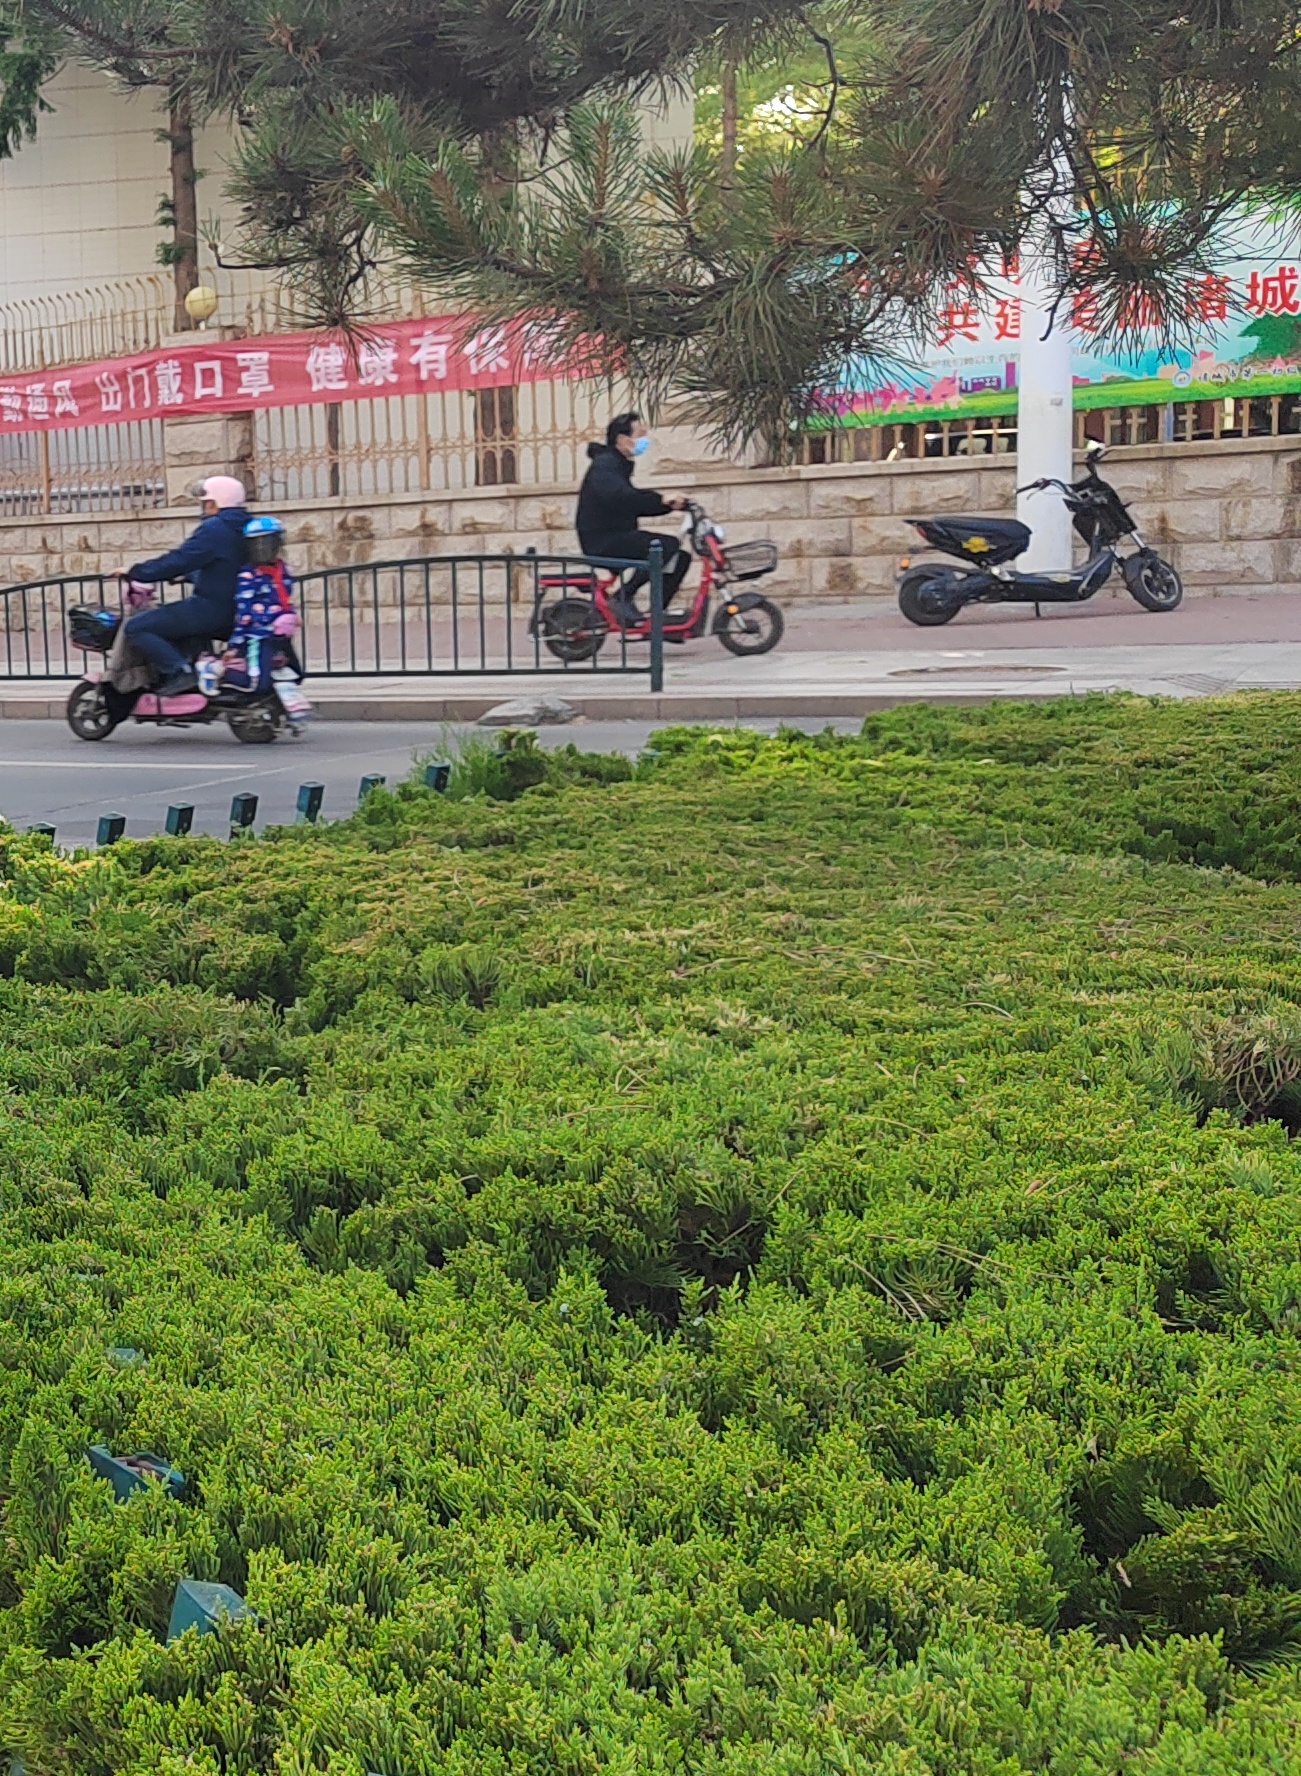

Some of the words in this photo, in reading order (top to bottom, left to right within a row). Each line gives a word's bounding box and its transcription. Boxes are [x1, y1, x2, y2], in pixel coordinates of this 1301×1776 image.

[95, 351, 275, 413] 出门戴口罩
